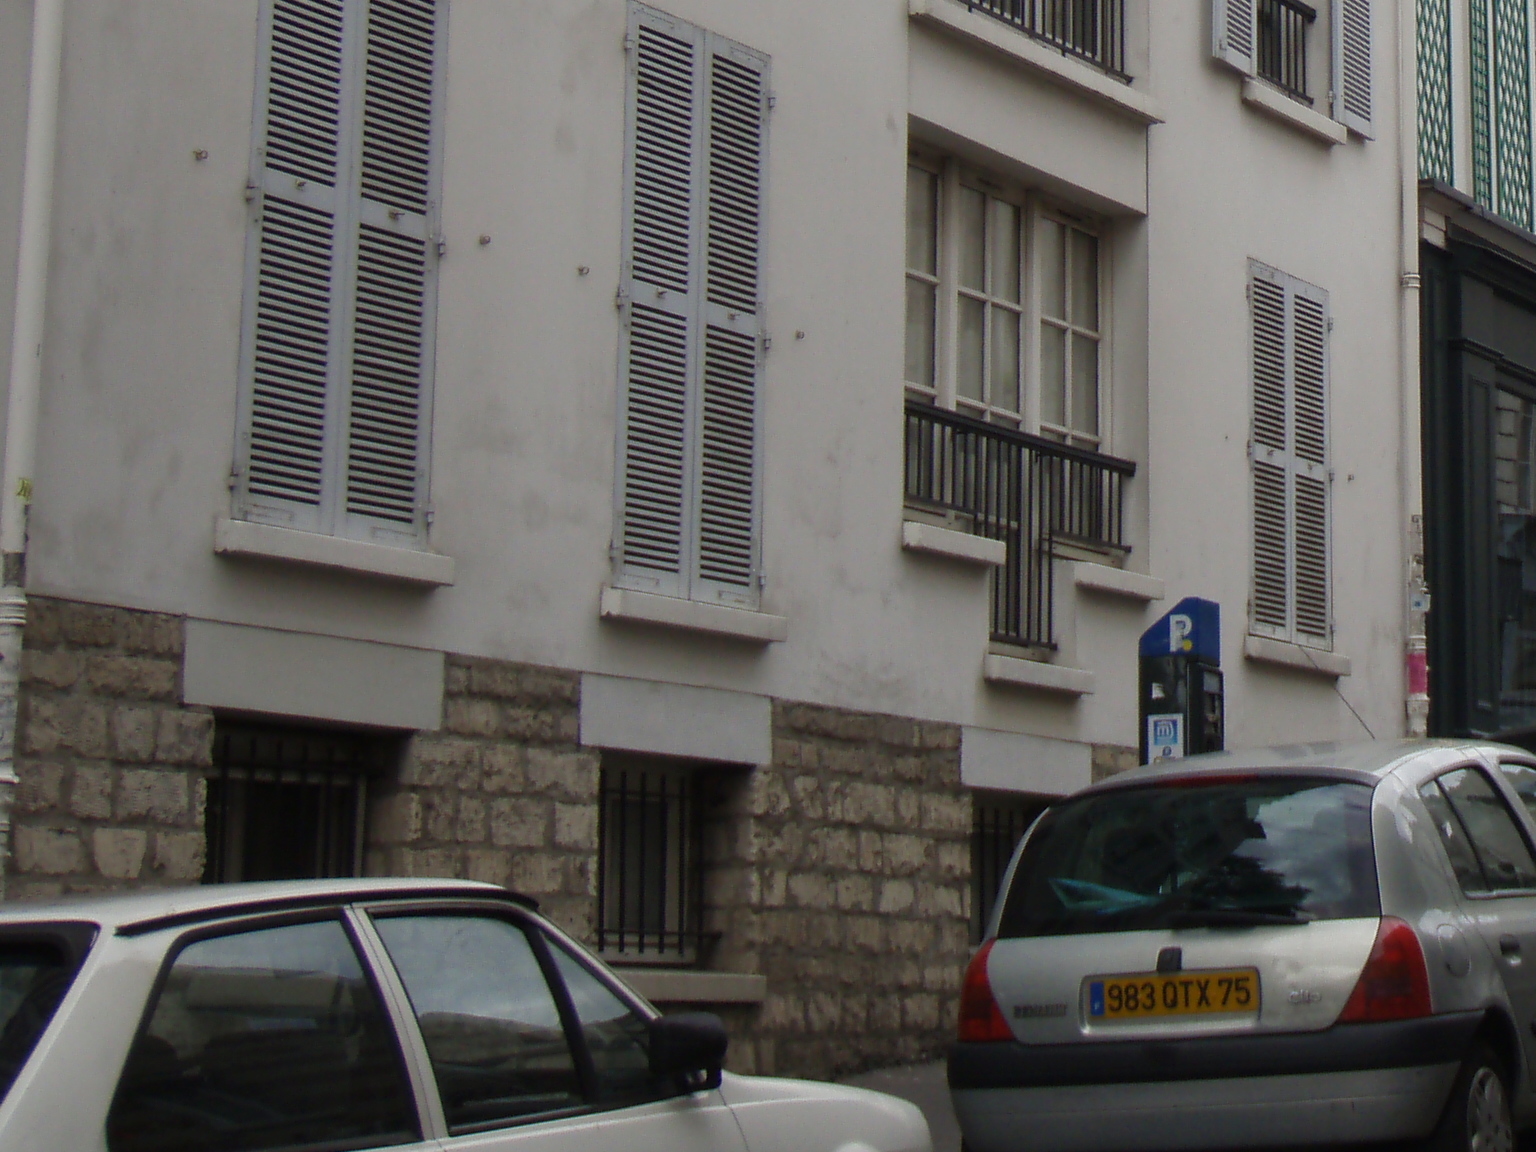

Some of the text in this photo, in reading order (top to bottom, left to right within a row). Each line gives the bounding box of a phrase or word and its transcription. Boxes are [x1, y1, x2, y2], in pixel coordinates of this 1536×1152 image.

[1169, 614, 1192, 652] P
[1107, 976, 1251, 1012] 983 QTX 75
